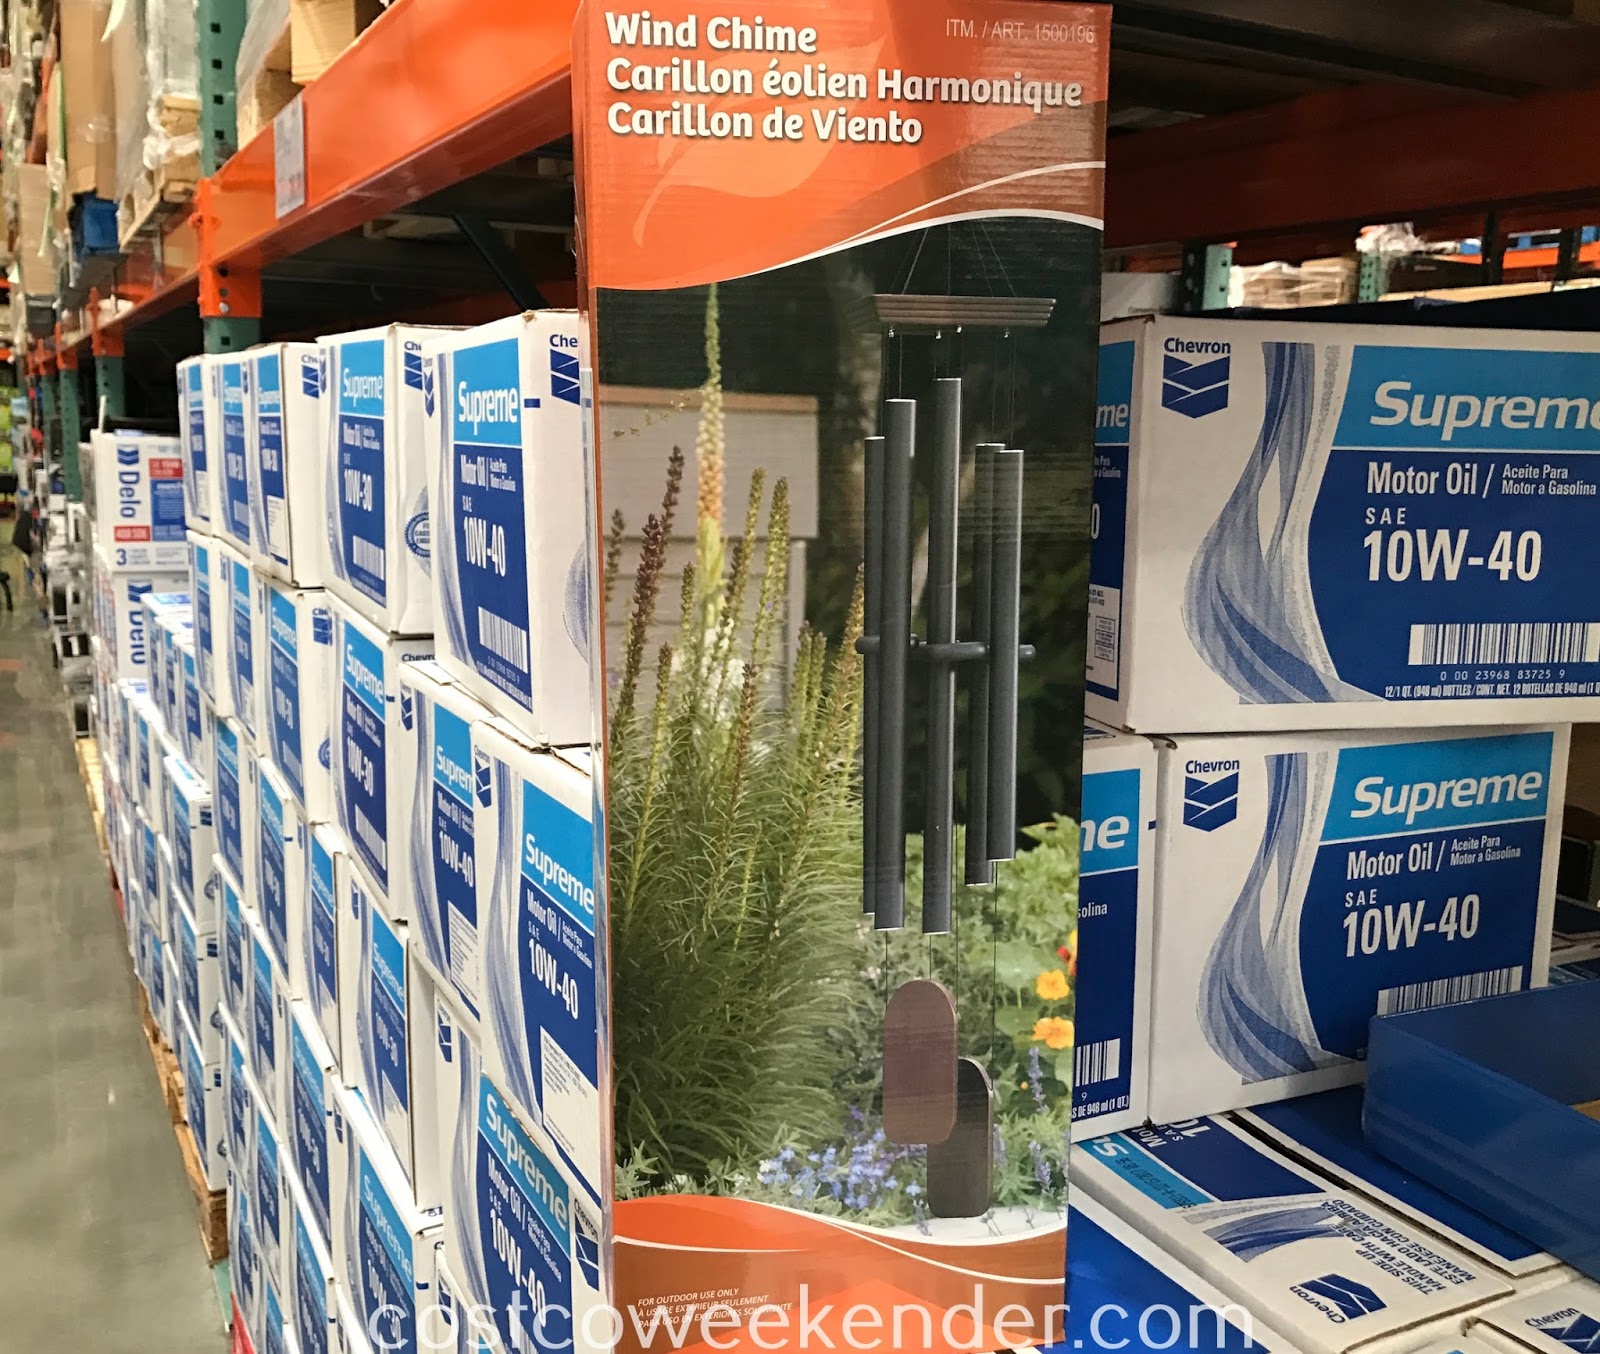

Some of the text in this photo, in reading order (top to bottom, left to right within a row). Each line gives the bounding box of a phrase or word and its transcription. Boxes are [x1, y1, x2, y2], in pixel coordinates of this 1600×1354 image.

[605, 11, 817, 53] Wind Chime
[946, 18, 977, 39] ITM.
[991, 21, 1028, 41] ART.
[1034, 22, 1095, 44] 1500196
[606, 58, 1082, 114] Carillon éolien Harmonique
[607, 102, 923, 144] Carillon de Viento
[550, 334, 578, 348] Che
[1163, 337, 1232, 355] Chevron
[343, 368, 384, 407] Supreme
[458, 381, 519, 436] Supreme
[1367, 461, 1440, 494] Motor
[1446, 462, 1479, 495] Oil
[1501, 480, 1597, 496] Motor a Gasolina
[1502, 463, 1568, 479] Aceite Para
[118, 471, 141, 519] Delo
[1364, 507, 1407, 525] SAE
[116, 548, 127, 566] 3
[463, 516, 506, 578] 10W-40
[1363, 528, 1543, 582] 10W-40
[346, 643, 384, 705] Supreme
[1440, 668, 1567, 681] 0 00 23968 83725 9
[1185, 757, 1241, 775] Chevron
[1350, 770, 1544, 826] Supreme
[439, 830, 474, 888] 10W-40
[1347, 850, 1404, 881] Motor
[1408, 841, 1434, 873] Oil
[1450, 845, 1521, 866] Motor a Gasolina
[1451, 835, 1500, 852] Aceite Para
[525, 833, 595, 916] Supreme
[527, 888, 546, 926] Motor
[547, 906, 557, 936] Oil
[1345, 888, 1378, 908] SAE
[1343, 893, 1480, 958] 10W-40
[528, 938, 579, 1020] 10W-40
[1081, 1091, 1088, 1102] 9
[486, 1092, 568, 1233] Supreme
[364, 1174, 412, 1283] Supreme
[1332, 1199, 1476, 1281] MANEJESE CON CUIDADO
[1361, 1225, 1401, 1247] HACIA
[490, 1208, 546, 1328] 10W-40
[1331, 1224, 1446, 1291] HANDLE WITH CARE
[1355, 1249, 1433, 1295] THIS SIDE UP
[1398, 1245, 1433, 1268] LADO
[1430, 1266, 1465, 1285] ESTE
[638, 1288, 739, 1307] FOR OUTDOOR USE ONLY
[646, 1305, 674, 1317] USAGE
[720, 1294, 769, 1307] SEULEMENT
[1289, 1285, 1346, 1324] Chevron
[1525, 1307, 1580, 1327] Chevron
